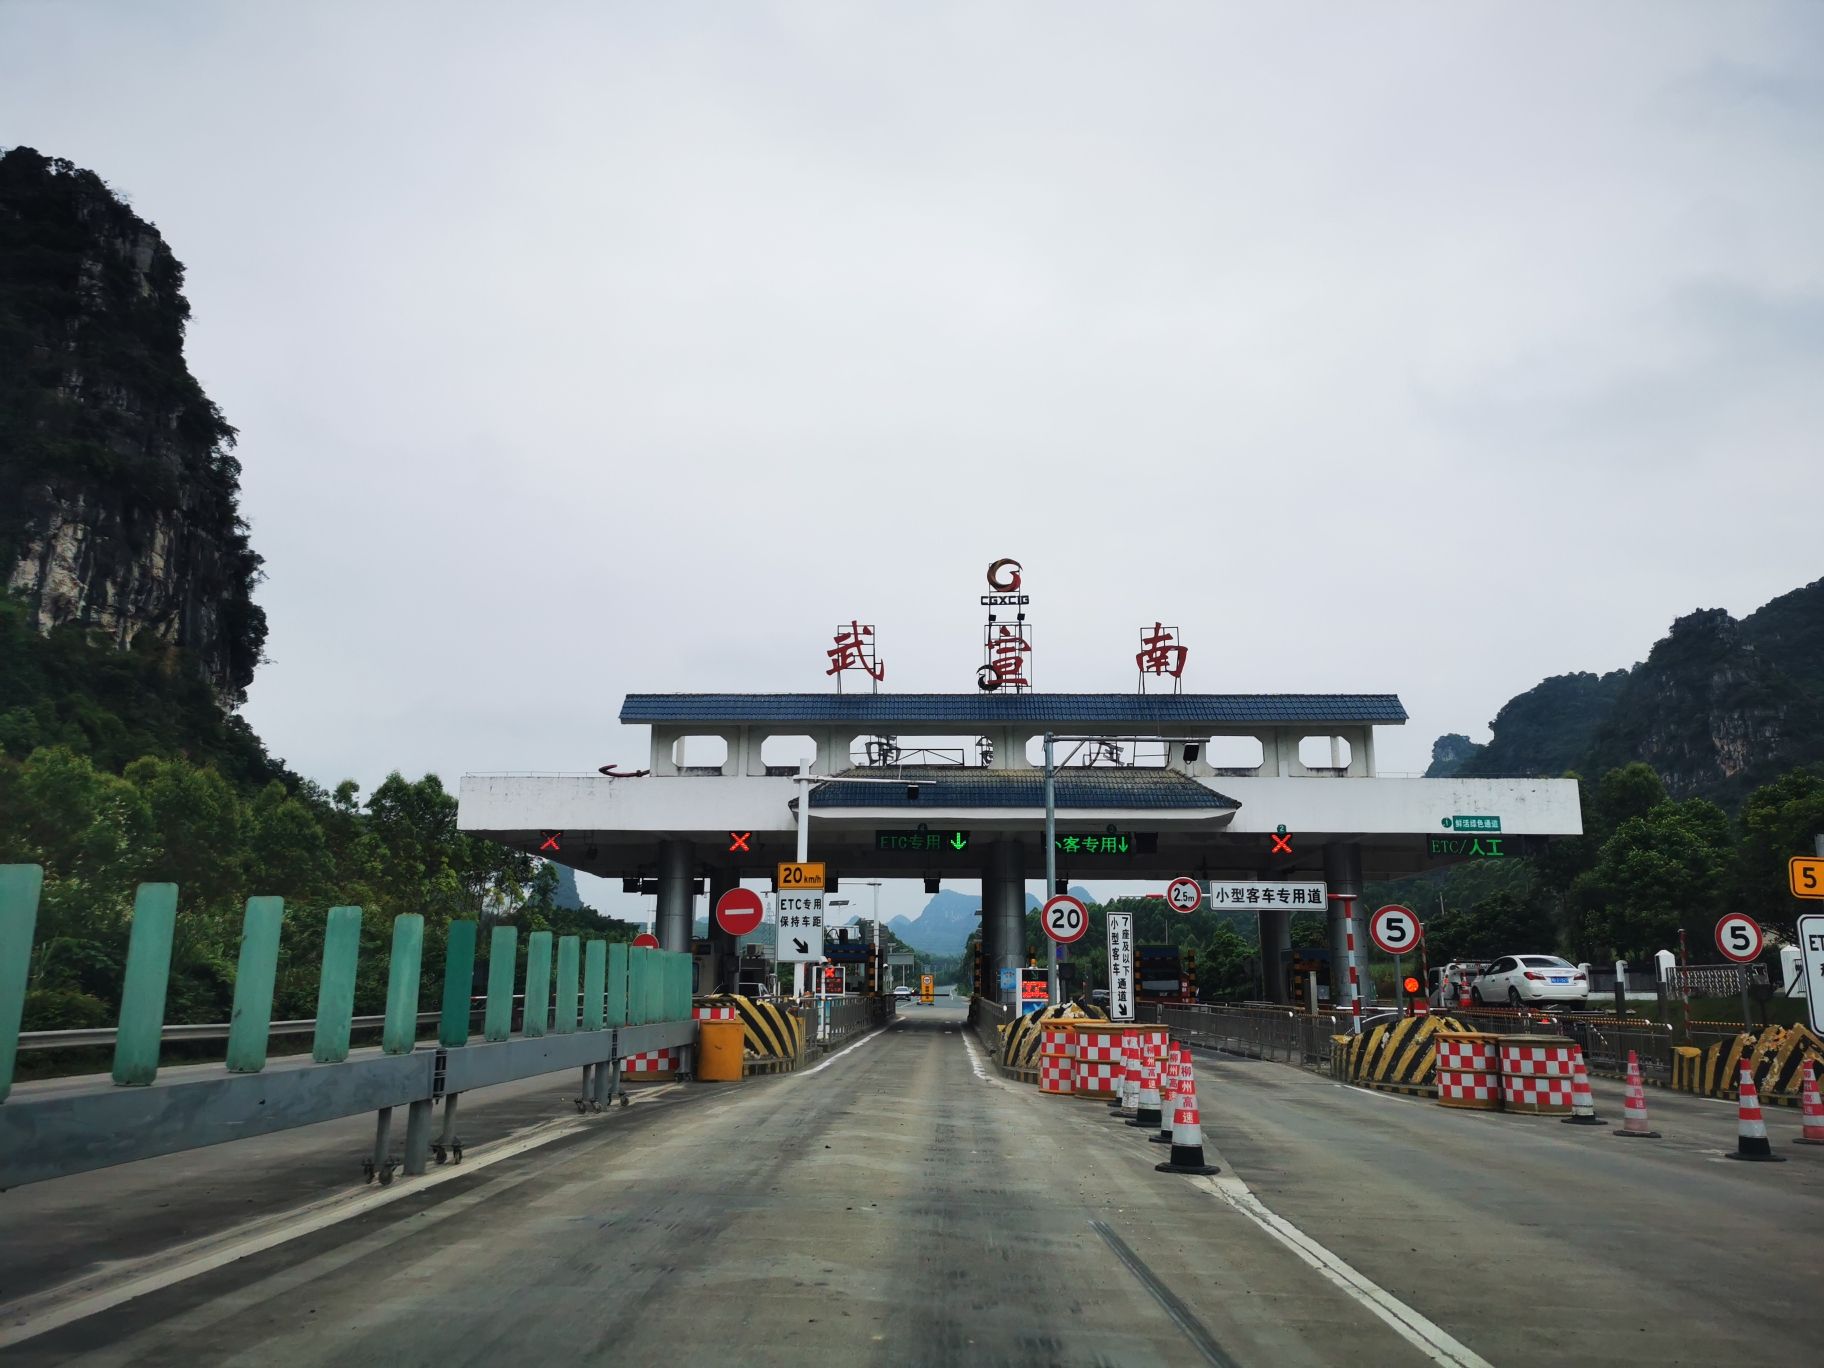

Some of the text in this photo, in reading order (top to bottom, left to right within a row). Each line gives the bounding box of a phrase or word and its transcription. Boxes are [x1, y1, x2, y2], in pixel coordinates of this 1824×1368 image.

[980, 595, 1029, 606] CGXCIG
[826, 619, 1188, 686] 武宣南
[879, 834, 941, 850] ETC专用
[1431, 838, 1505, 856] ETC/人工
[783, 867, 822, 884] 20 km/h
[1802, 866, 1817, 889] 5
[780, 898, 822, 911] ETC专用
[1173, 887, 1195, 903] 2.5m
[1215, 887, 1323, 905] 小型客车专用道
[780, 915, 822, 928] 保持车距
[1052, 908, 1081, 930] 20
[1386, 917, 1407, 943] 5
[1110, 916, 1121, 976] 小型客车
[1121, 916, 1131, 976] 7座及以下
[1730, 925, 1751, 951] 5
[1117, 978, 1128, 1002] 通道
[1181, 1066, 1194, 1124] 柳州高速
